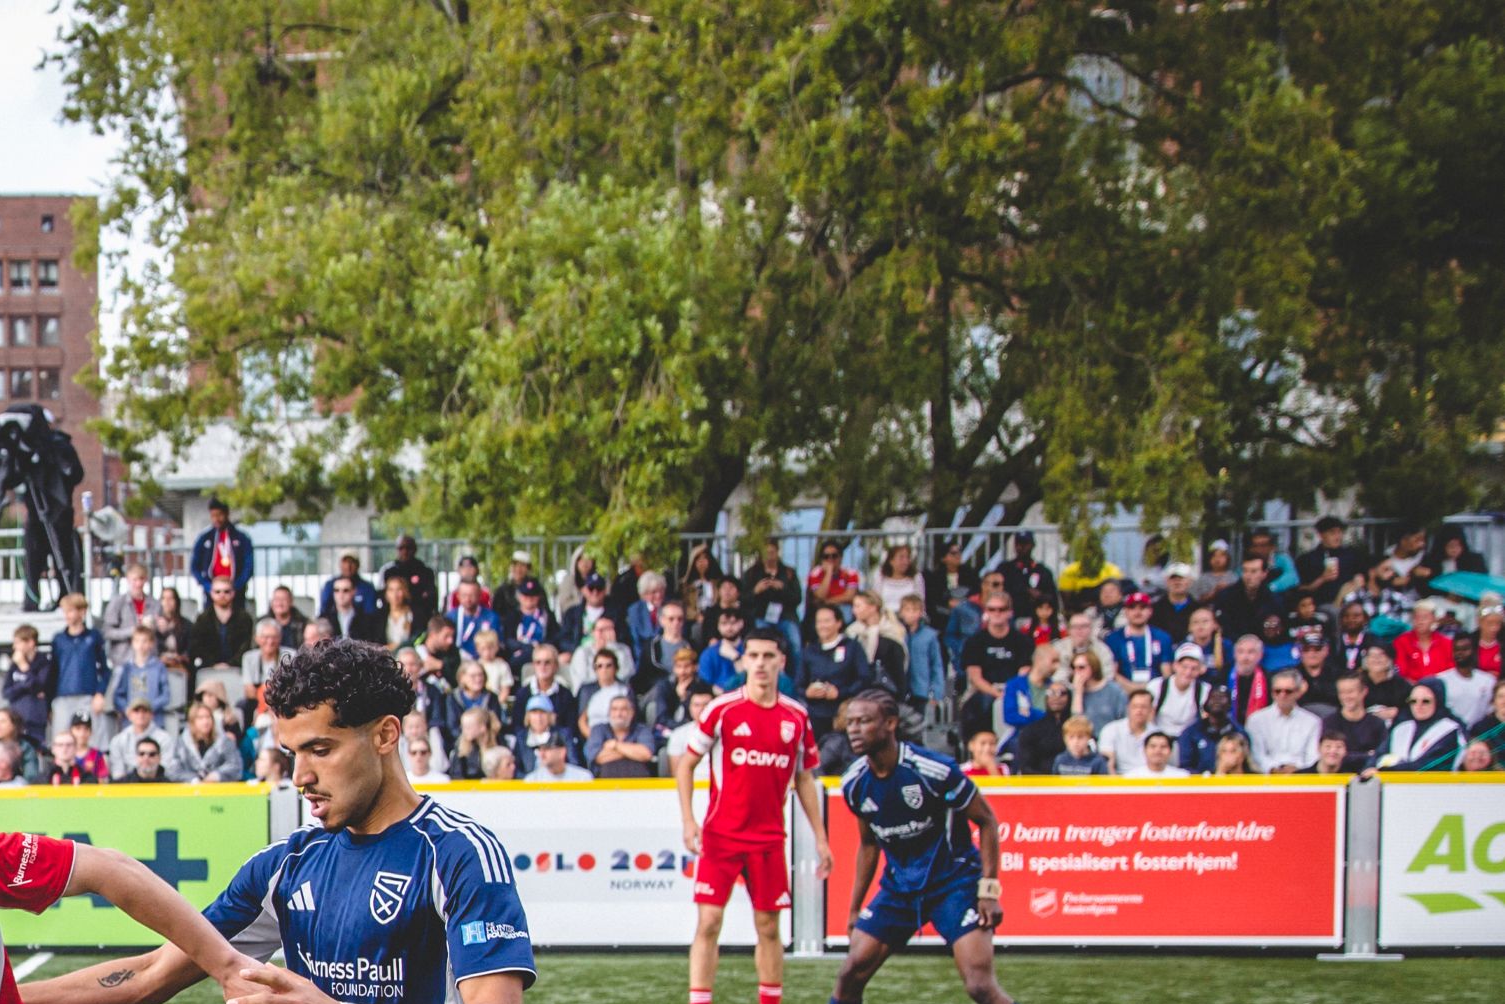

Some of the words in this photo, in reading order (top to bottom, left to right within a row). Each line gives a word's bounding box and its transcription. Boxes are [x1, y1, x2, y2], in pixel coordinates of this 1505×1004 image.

[1013, 822, 1060, 842] barn
[1064, 824, 1138, 847] trenger
[1140, 821, 1276, 842] fosterforeldre
[9, 848, 32, 887] Burness
[1000, 851, 1024, 872] Bli
[1028, 852, 1129, 876] spesialisert
[1133, 851, 1239, 875] fosterhjem!
[610, 880, 675, 890] NORWAY
[356, 956, 403, 982] Paull
[331, 982, 404, 998] FOUNDATION
